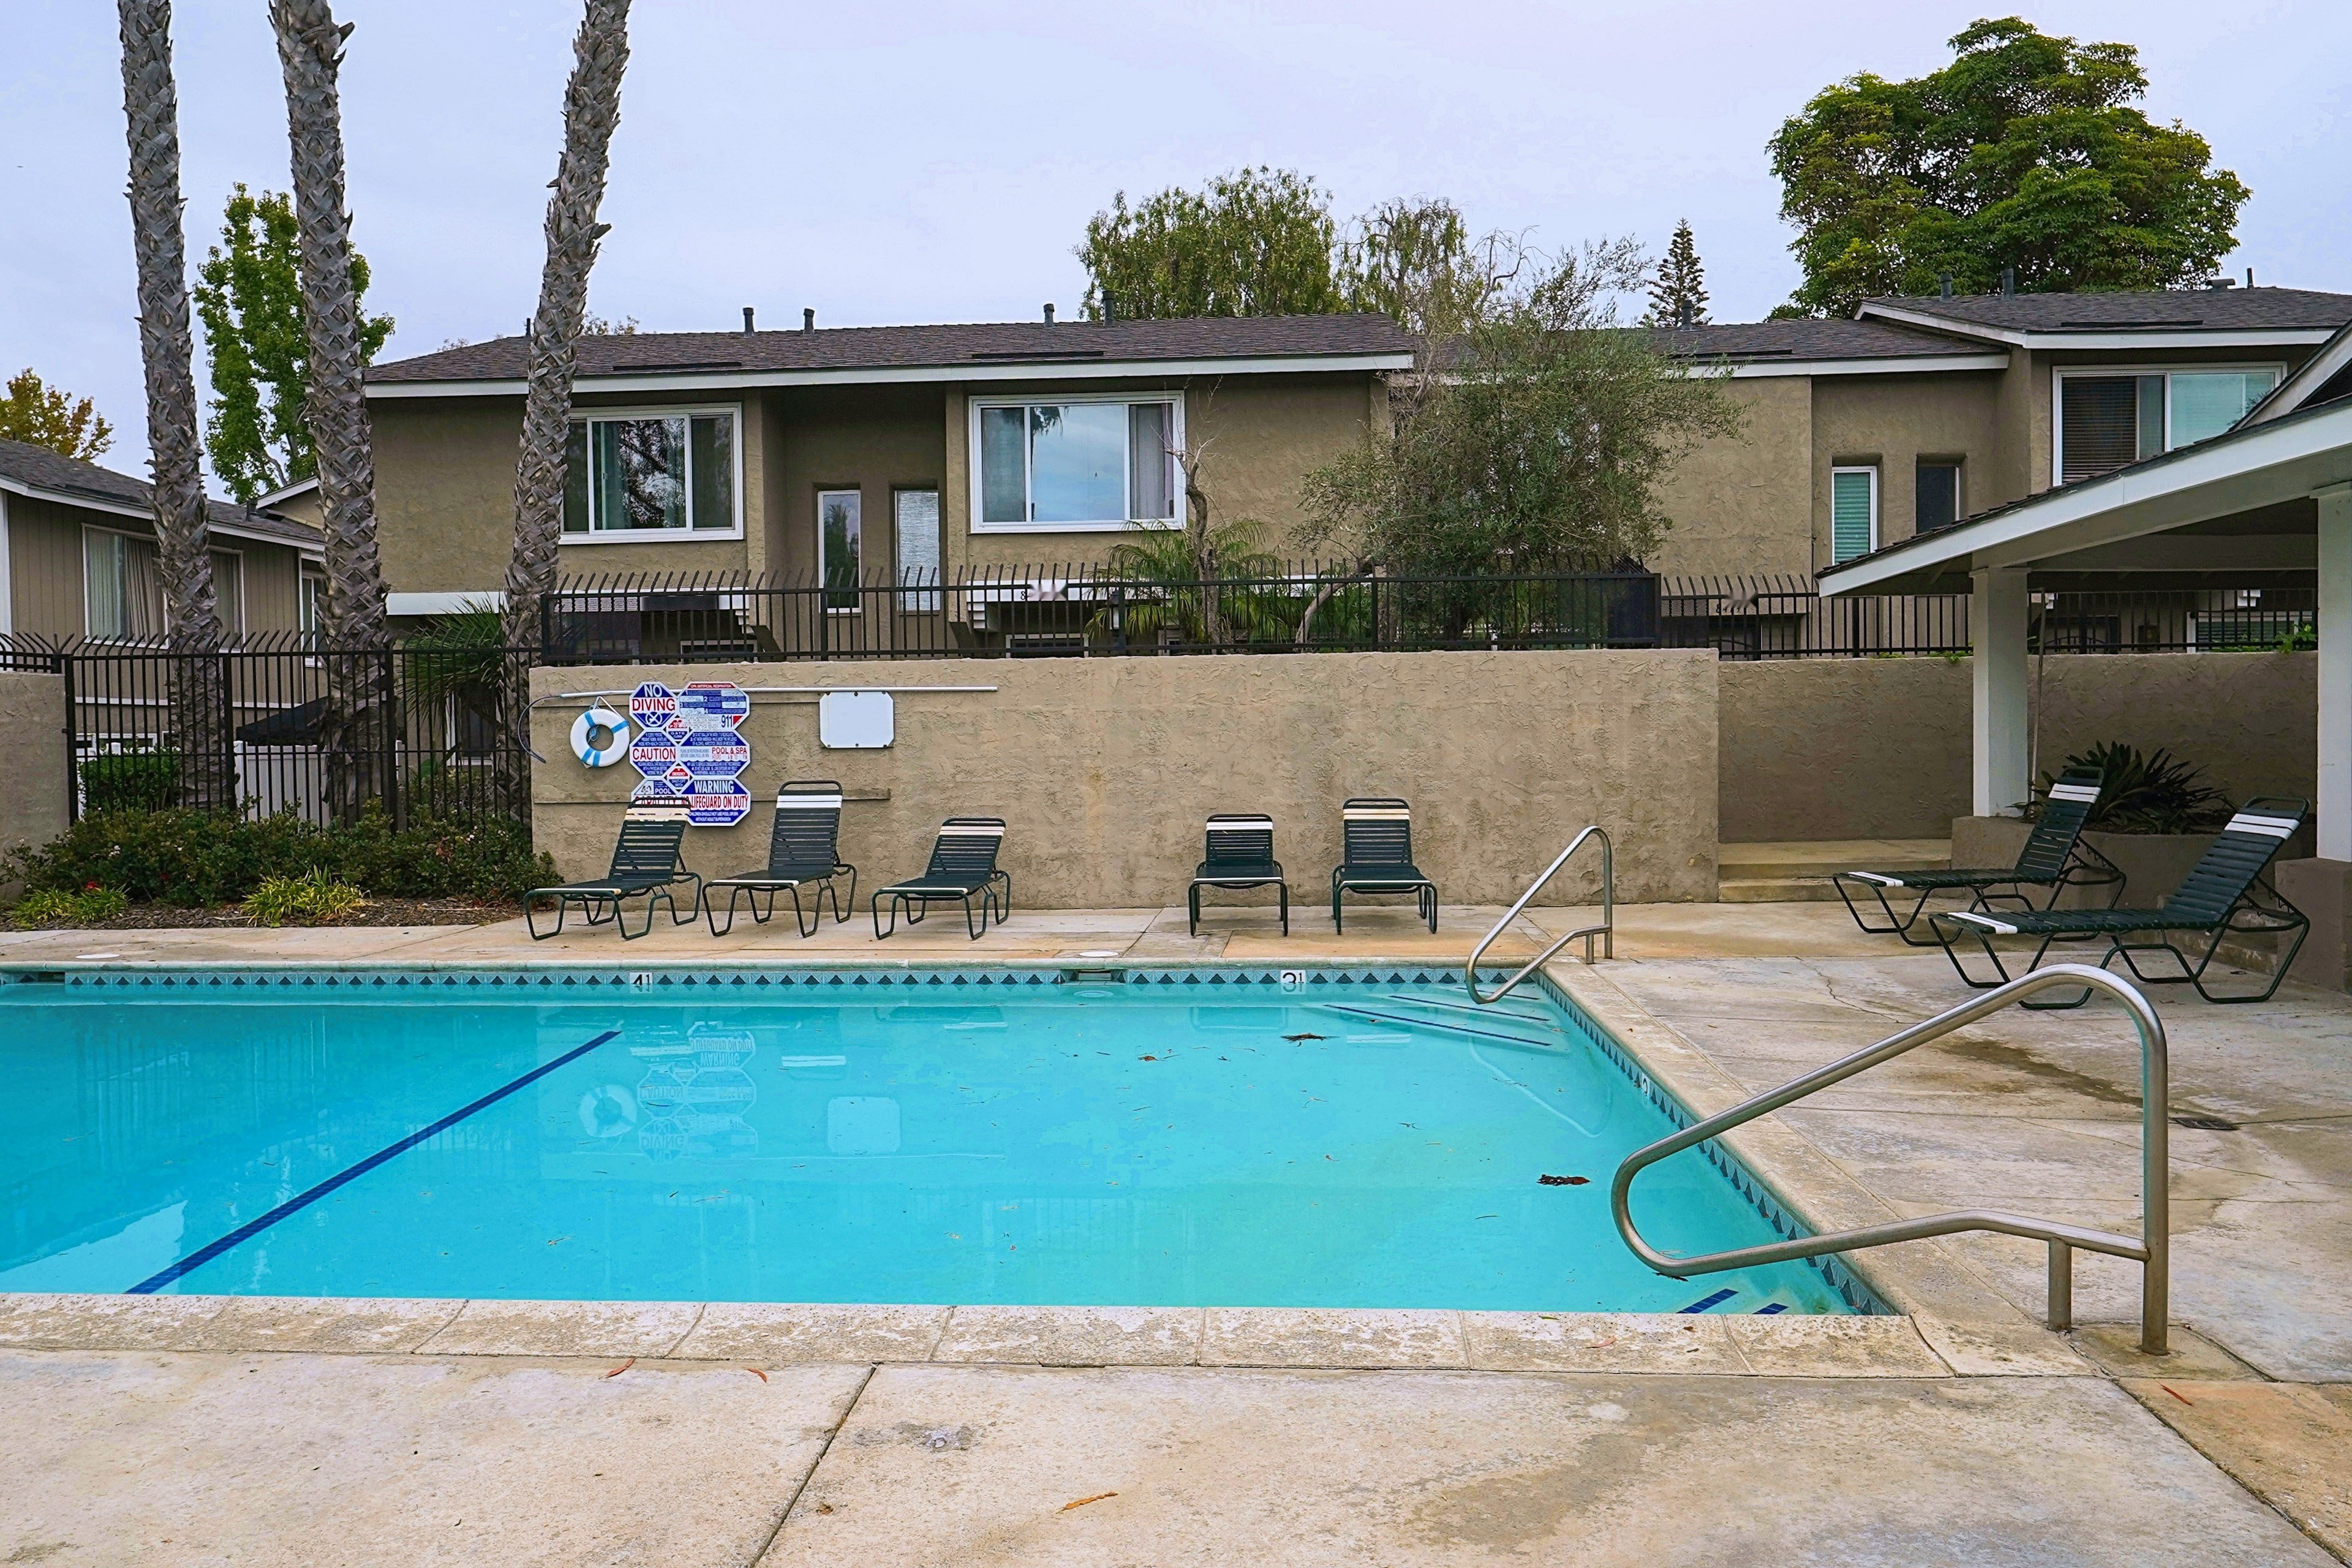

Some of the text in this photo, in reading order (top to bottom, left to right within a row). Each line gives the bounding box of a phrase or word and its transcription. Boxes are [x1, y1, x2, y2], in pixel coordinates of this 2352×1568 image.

[644, 684, 662, 697] NO
[631, 698, 676, 711] DIVING
[722, 715, 733, 728] 911
[633, 748, 676, 760] CAUTION
[694, 780, 734, 794] WARNING
[691, 796, 722, 808] LIFEGUARD
[723, 796, 731, 808] ON
[734, 796, 748, 808] DUTY
